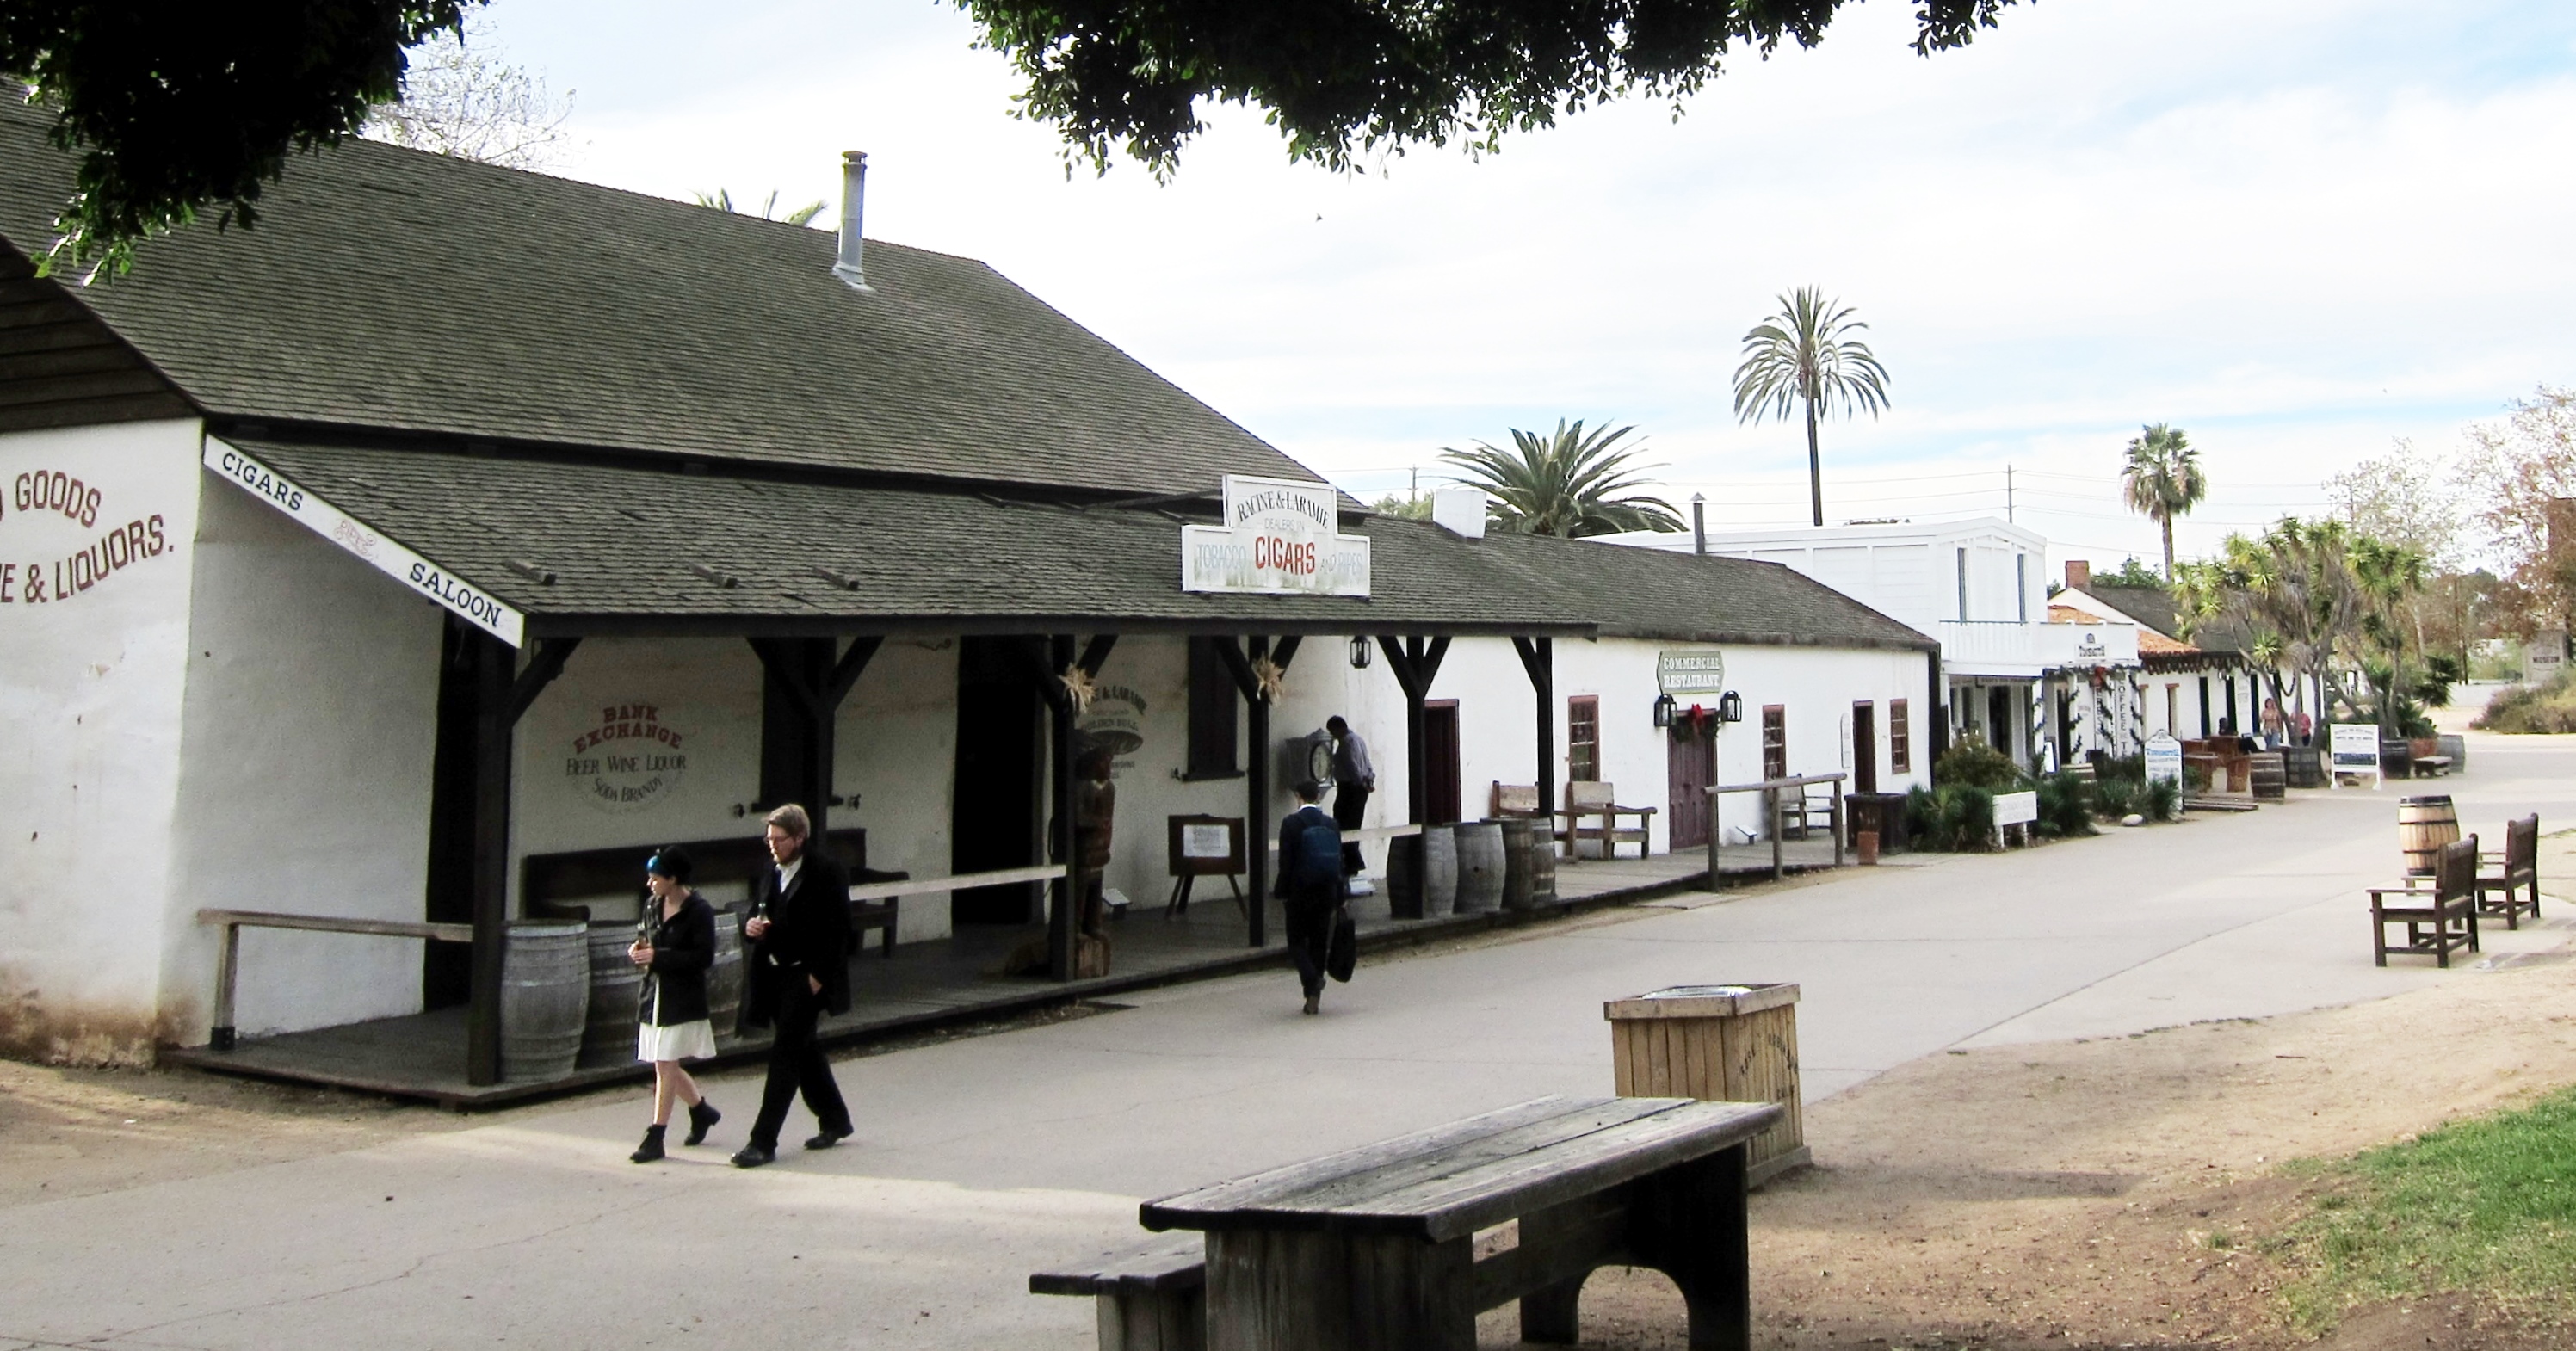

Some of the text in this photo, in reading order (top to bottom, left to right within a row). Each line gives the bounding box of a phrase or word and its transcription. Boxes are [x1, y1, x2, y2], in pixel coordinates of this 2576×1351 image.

[16, 470, 102, 529] GOODS
[1237, 491, 1276, 522] RACINE
[1286, 491, 1330, 530] LARAMIE
[222, 452, 304, 512] CIGARS
[409, 562, 503, 628] SALOON
[1264, 517, 1306, 533] DEALERS IN
[25, 564, 48, 603] &
[56, 514, 175, 601] LIQUORS.
[1197, 544, 1247, 569] TOBACCO
[1255, 535, 1316, 576] CIGARS
[1663, 657, 1720, 670] COMMERCIAL
[1663, 674, 1720, 688] RESTAURANT
[603, 704, 659, 724] BANK
[573, 723, 683, 755] EXCHANGE
[566, 754, 687, 775] BEER WINE LIQUOR
